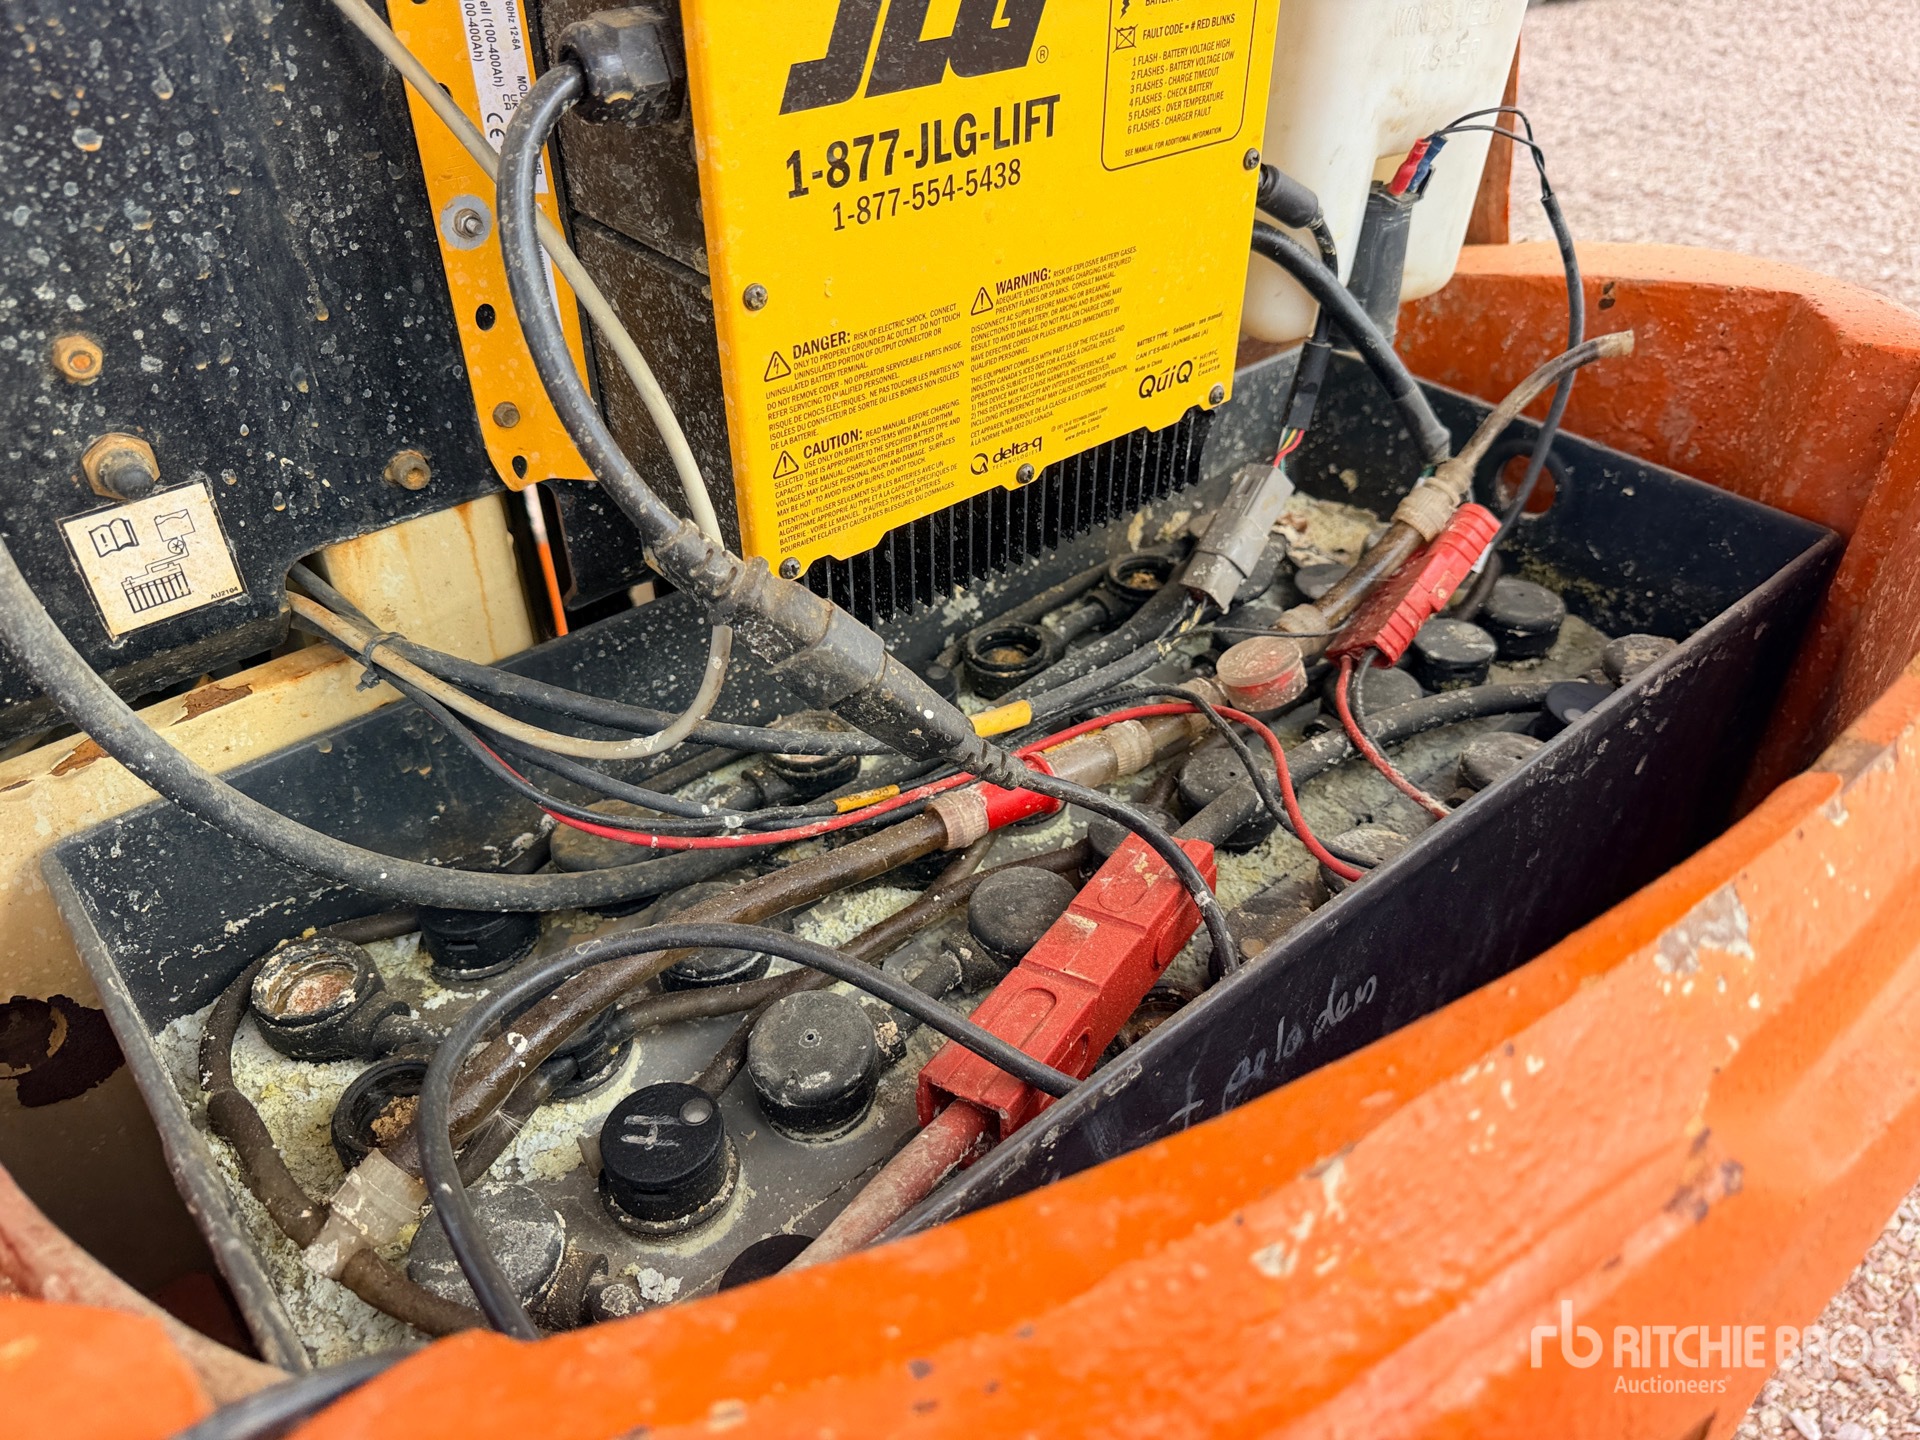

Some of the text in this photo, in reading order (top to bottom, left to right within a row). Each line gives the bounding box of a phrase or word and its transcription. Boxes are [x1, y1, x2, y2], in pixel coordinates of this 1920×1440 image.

[463, 0, 485, 62] 00-400Ah)
[504, 0, 522, 51] 60Hz 12-6A
[1142, 27, 1162, 40] FAULT
[1164, 23, 1183, 35] CODE
[1196, 18, 1210, 29] RED
[1211, 13, 1235, 26] BLINKS
[480, 18, 505, 87] (100-400Ah)
[1130, 71, 1135, 80] 2
[1136, 65, 1164, 78] FLASHES
[1169, 59, 1194, 72] BATTERY
[1195, 53, 1220, 66] VOLTAGE
[1221, 50, 1234, 60] LOW
[1132, 57, 1136, 66] 1
[1137, 53, 1157, 65] FLASH
[1162, 47, 1187, 60] BATTERY
[1189, 41, 1214, 54] VOLTAGE
[1215, 38, 1230, 48] HIGH
[1128, 98, 1133, 107] 4
[1134, 92, 1162, 105] FLASHES
[1166, 86, 1187, 98] CHECK
[1188, 81, 1212, 93] BATTERY
[1129, 85, 1134, 93] 3
[1135, 78, 1163, 92] FLASHES
[1168, 72, 1192, 85] CHARGE
[1194, 66, 1219, 79] TIMEOUT
[1127, 125, 1131, 134] 6
[1132, 119, 1159, 132] FLASHES
[1164, 111, 1192, 125] CHARGER
[1193, 106, 1211, 118] FAULT
[1128, 112, 1132, 120] 5
[1133, 105, 1160, 119] FLASHES
[1165, 101, 1181, 111] OVER
[1183, 91, 1223, 107] TEMPERATURE
[786, 94, 1061, 199] 1-877-JLG-LIFT
[832, 158, 1022, 232] 1-877-554-5438
[996, 267, 1050, 295] WARNING:
[792, 329, 850, 359] DANGER:
[853, 331, 867, 341] RISK
[878, 319, 904, 333] ELECTRIC
[930, 303, 956, 317] CONNECT
[793, 359, 809, 369] ONLY
[819, 346, 850, 361] PROPERLY
[851, 335, 885, 351] GROUNDED
[920, 322, 928, 330] DO
[929, 318, 940, 327] NOT
[942, 312, 960, 323] TOUCH
[794, 361, 836, 379] UNINSULATED
[838, 352, 864, 366] PORTION
[874, 342, 896, 354] OUTPUT
[898, 331, 932, 347] CONNECTOR
[765, 380, 809, 399] UNINSULATED
[810, 371, 835, 385] BATTERY
[766, 401, 776, 410] DO
[777, 397, 789, 406] NOT
[791, 388, 816, 402] REMOVE
[818, 381, 838, 393] COVER
[843, 376, 852, 385] NO
[854, 366, 884, 382] OPERATOR
[885, 354, 922, 371] SERVICEABLE
[924, 348, 941, 359] PARTS
[768, 408, 787, 420] REFER
[789, 397, 822, 413] SERVICING
[832, 384, 862, 399] QUALIFIED
[803, 428, 862, 459] CAUTION:
[804, 460, 815, 469] USE
[817, 454, 832, 464] ONLY
[834, 450, 843, 458] ON
[844, 441, 868, 454] BATTERY
[870, 431, 895, 445] SYSTEMS
[897, 426, 910, 435] WITH
[921, 411, 952, 427] ALGORITHM
[992, 435, 1042, 463] delta-q
[992, 449, 1039, 470] TECHNOLOGIES
[210, 586, 239, 600] AU2104
